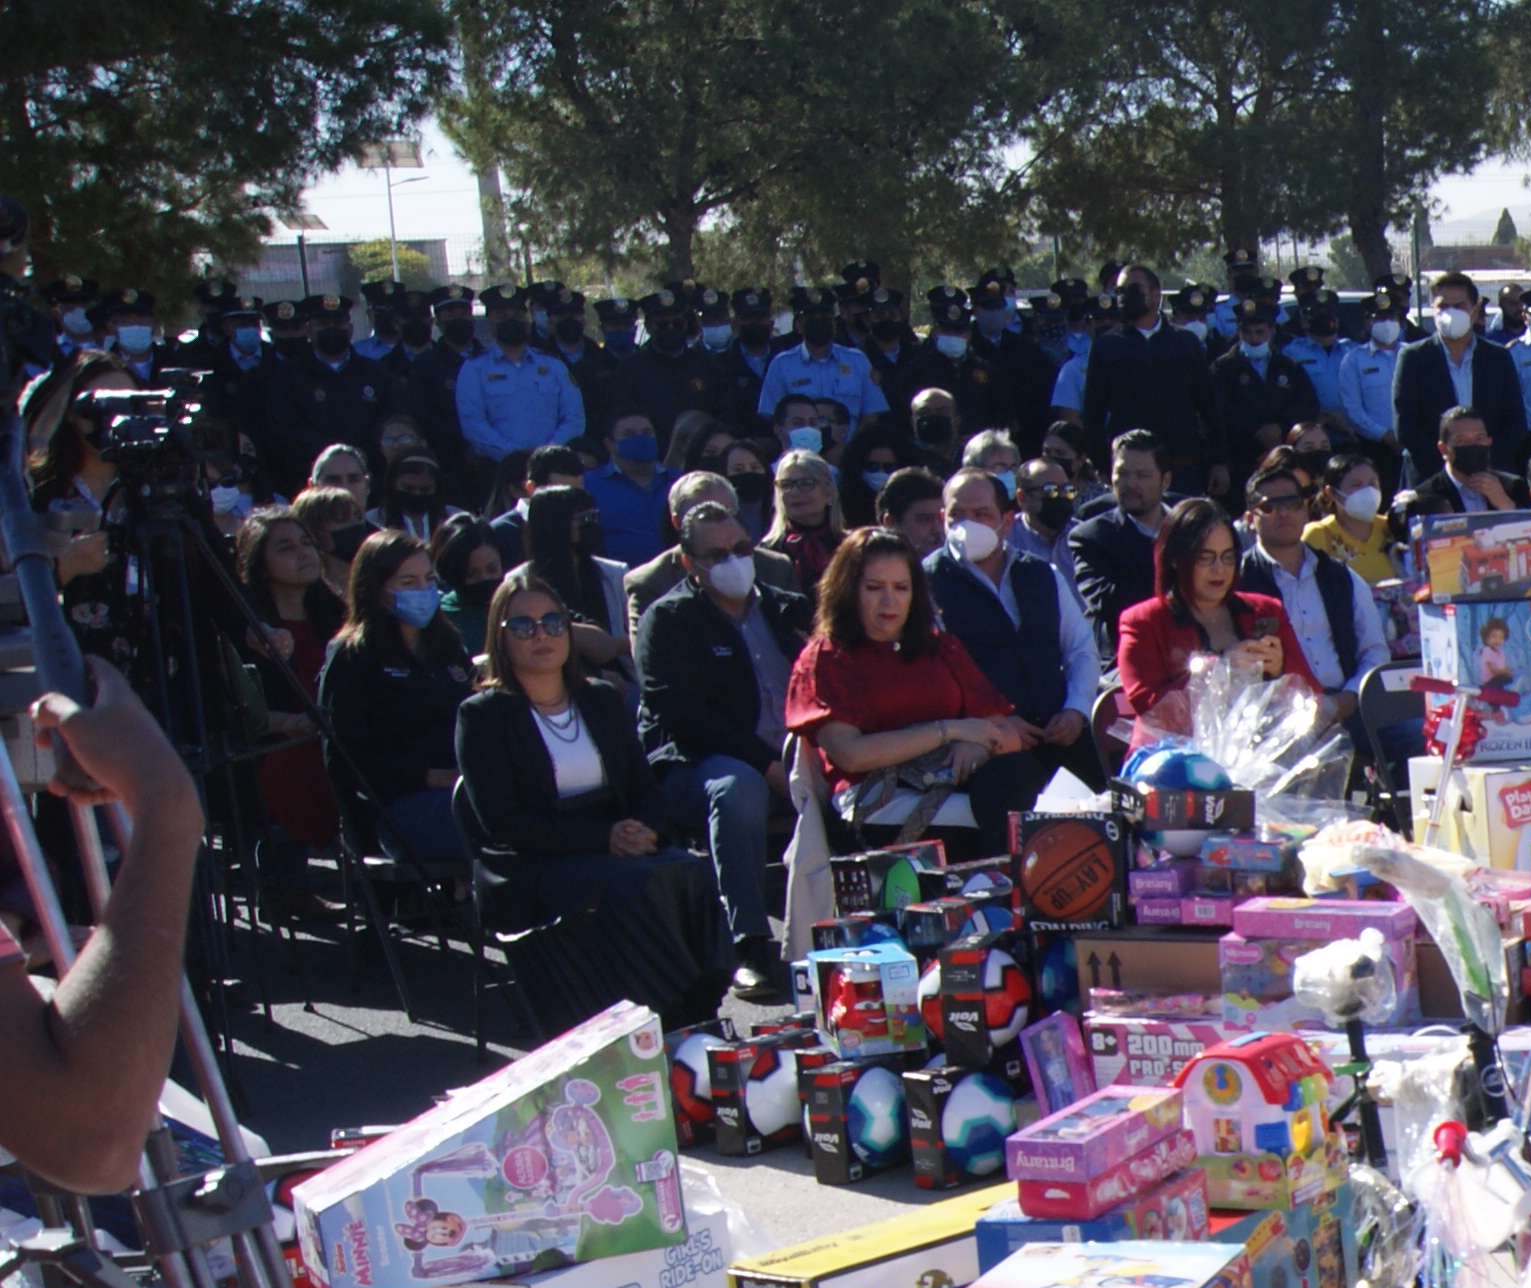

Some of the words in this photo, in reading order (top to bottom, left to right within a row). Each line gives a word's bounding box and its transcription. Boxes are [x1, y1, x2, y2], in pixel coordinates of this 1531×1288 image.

[1479, 740, 1525, 752] ROZEN
[1092, 1033, 1117, 1051] 8+
[1014, 1150, 1076, 1173] Brittany
[348, 1218, 374, 1288] MINNIE
